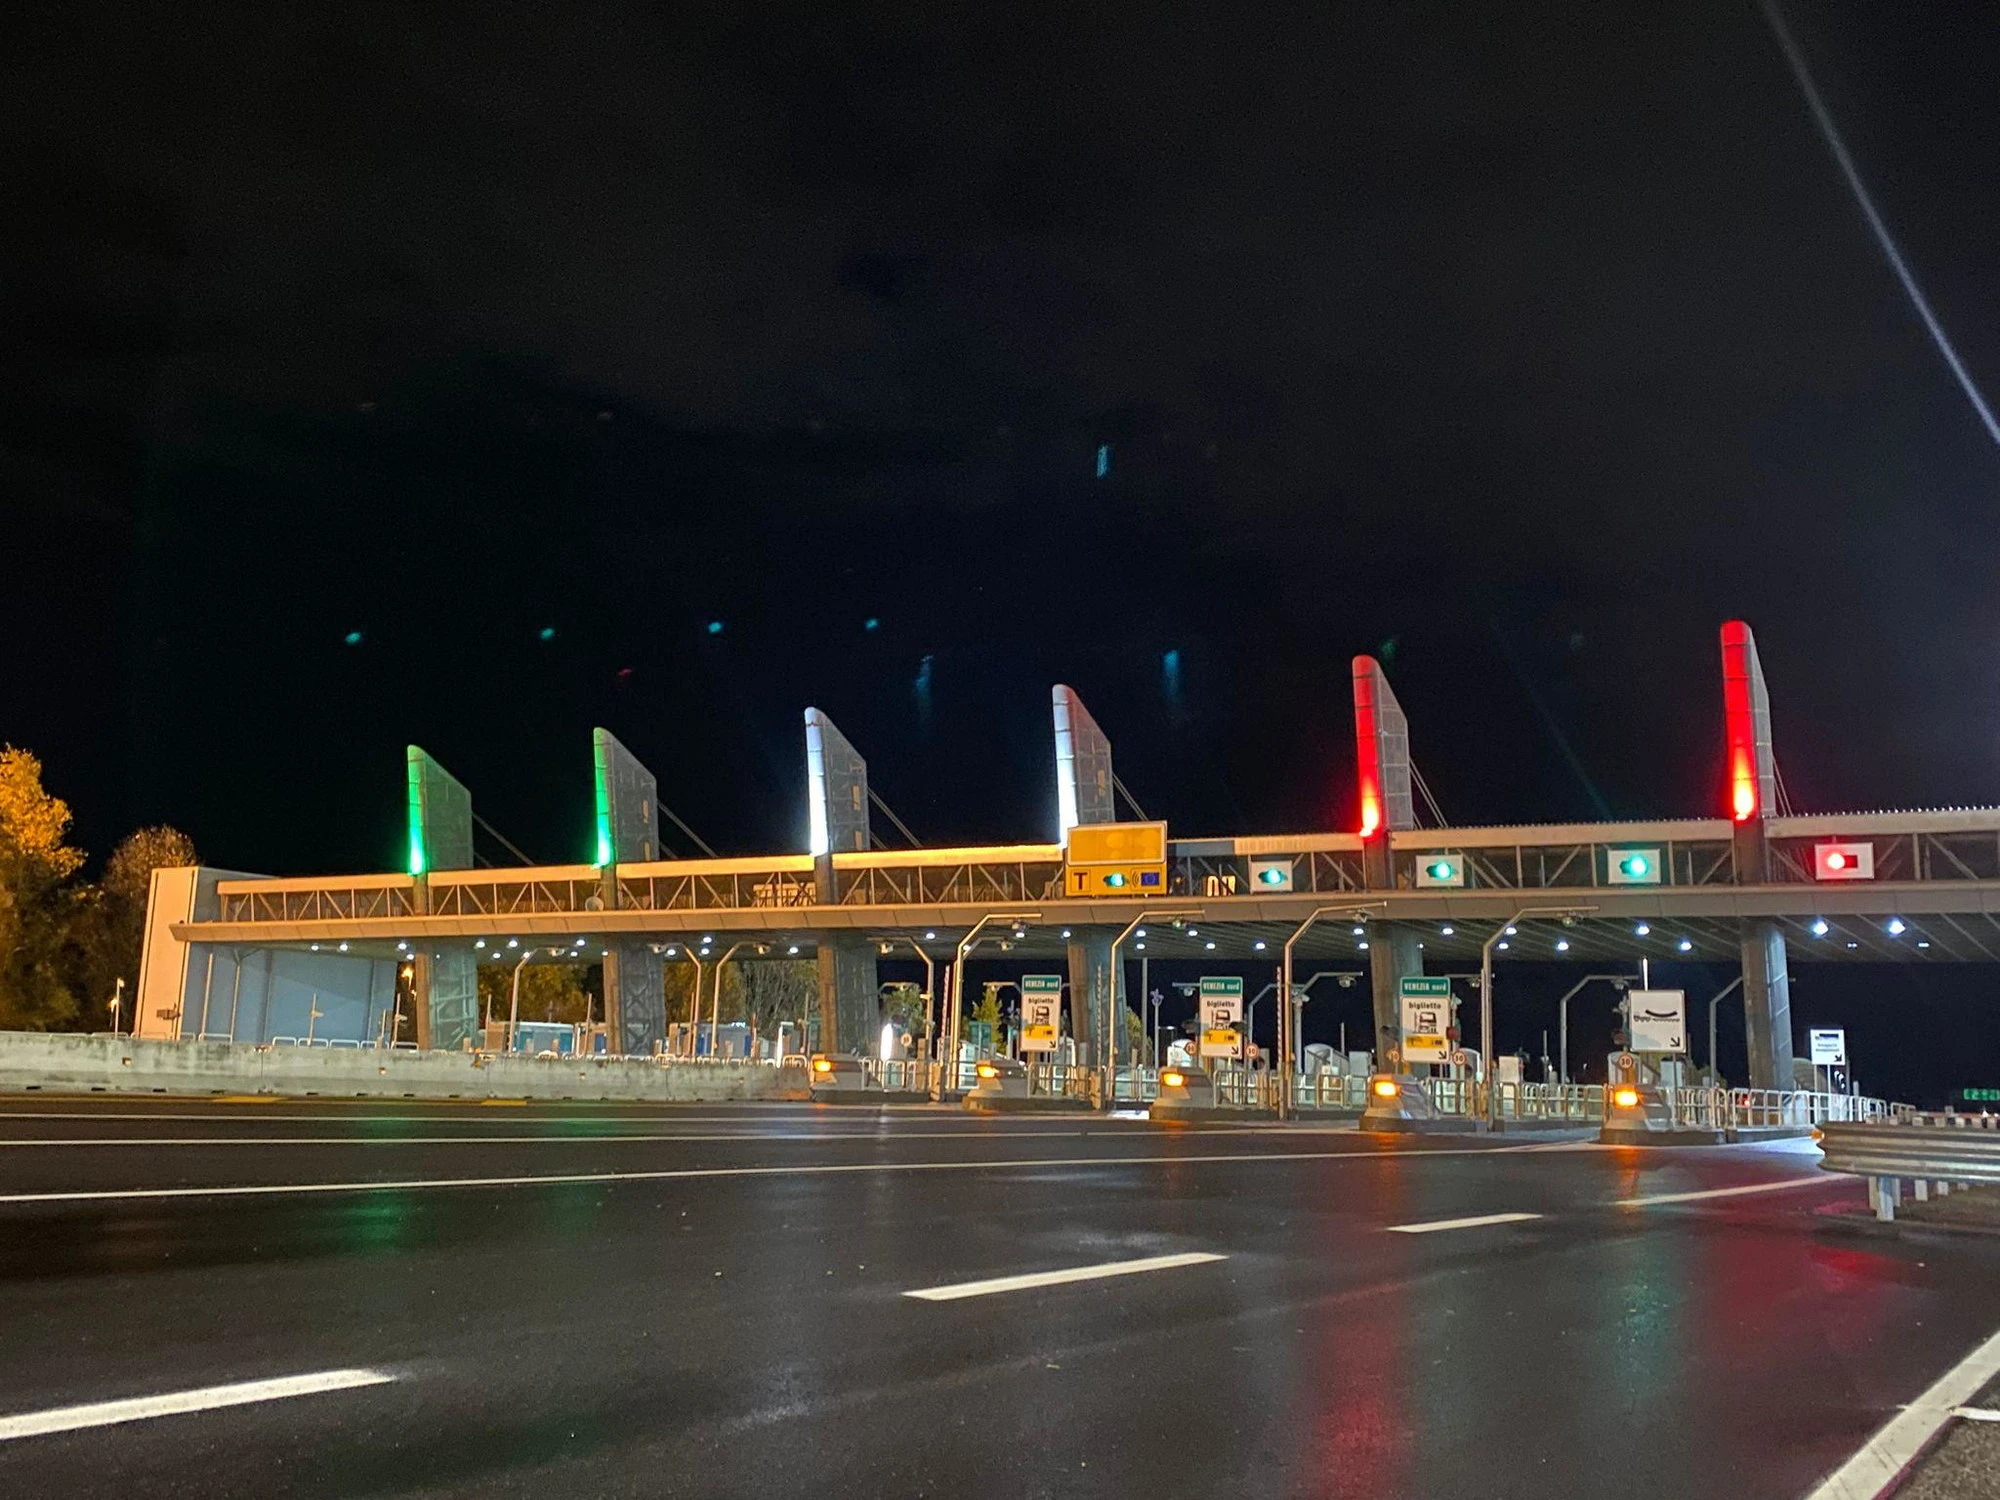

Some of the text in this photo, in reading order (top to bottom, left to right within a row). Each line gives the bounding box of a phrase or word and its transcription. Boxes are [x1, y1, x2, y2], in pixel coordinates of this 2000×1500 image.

[1073, 872, 1088, 890] T
[1203, 982, 1239, 990] VENEZIA nord
[1404, 983, 1446, 991] VENEZIA nord
[1206, 1000, 1235, 1008] biglietto
